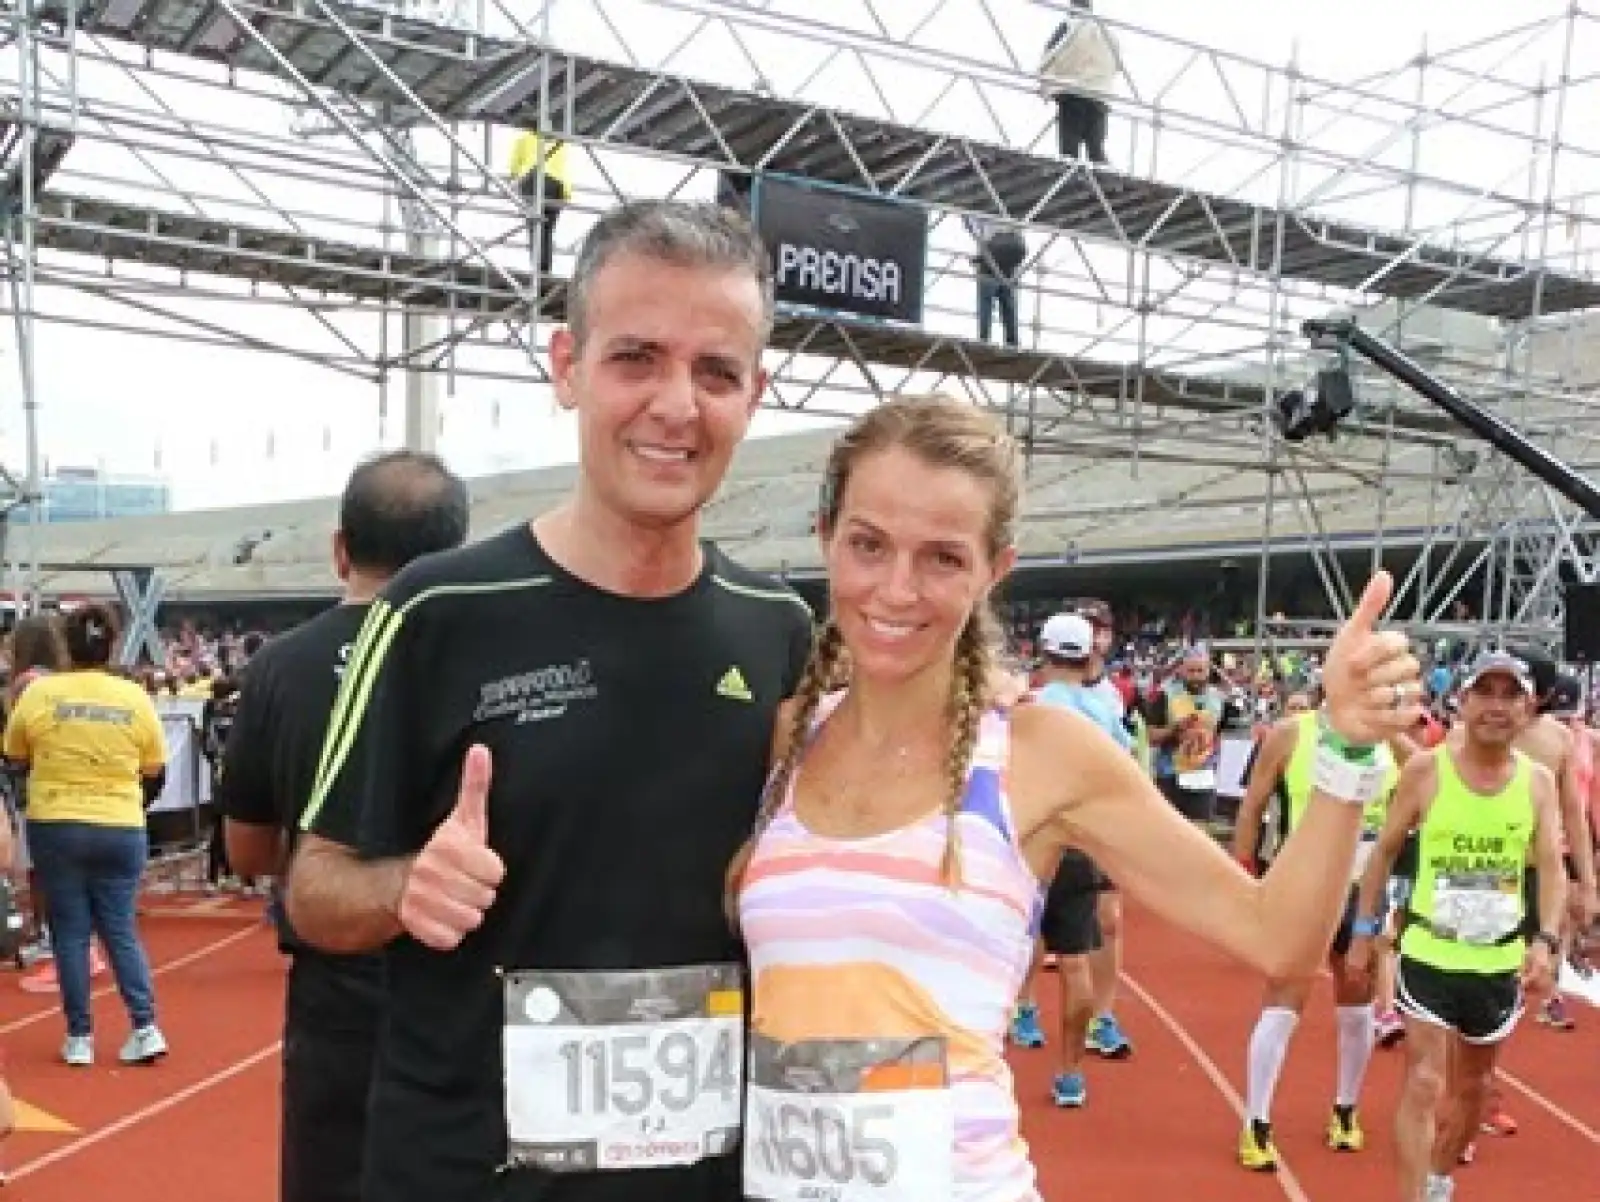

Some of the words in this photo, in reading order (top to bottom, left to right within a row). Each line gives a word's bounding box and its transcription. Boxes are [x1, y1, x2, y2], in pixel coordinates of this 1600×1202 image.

[776, 243, 902, 304] PRENSA
[1452, 834, 1505, 853] CLUB
[558, 1028, 737, 1117] 11594
